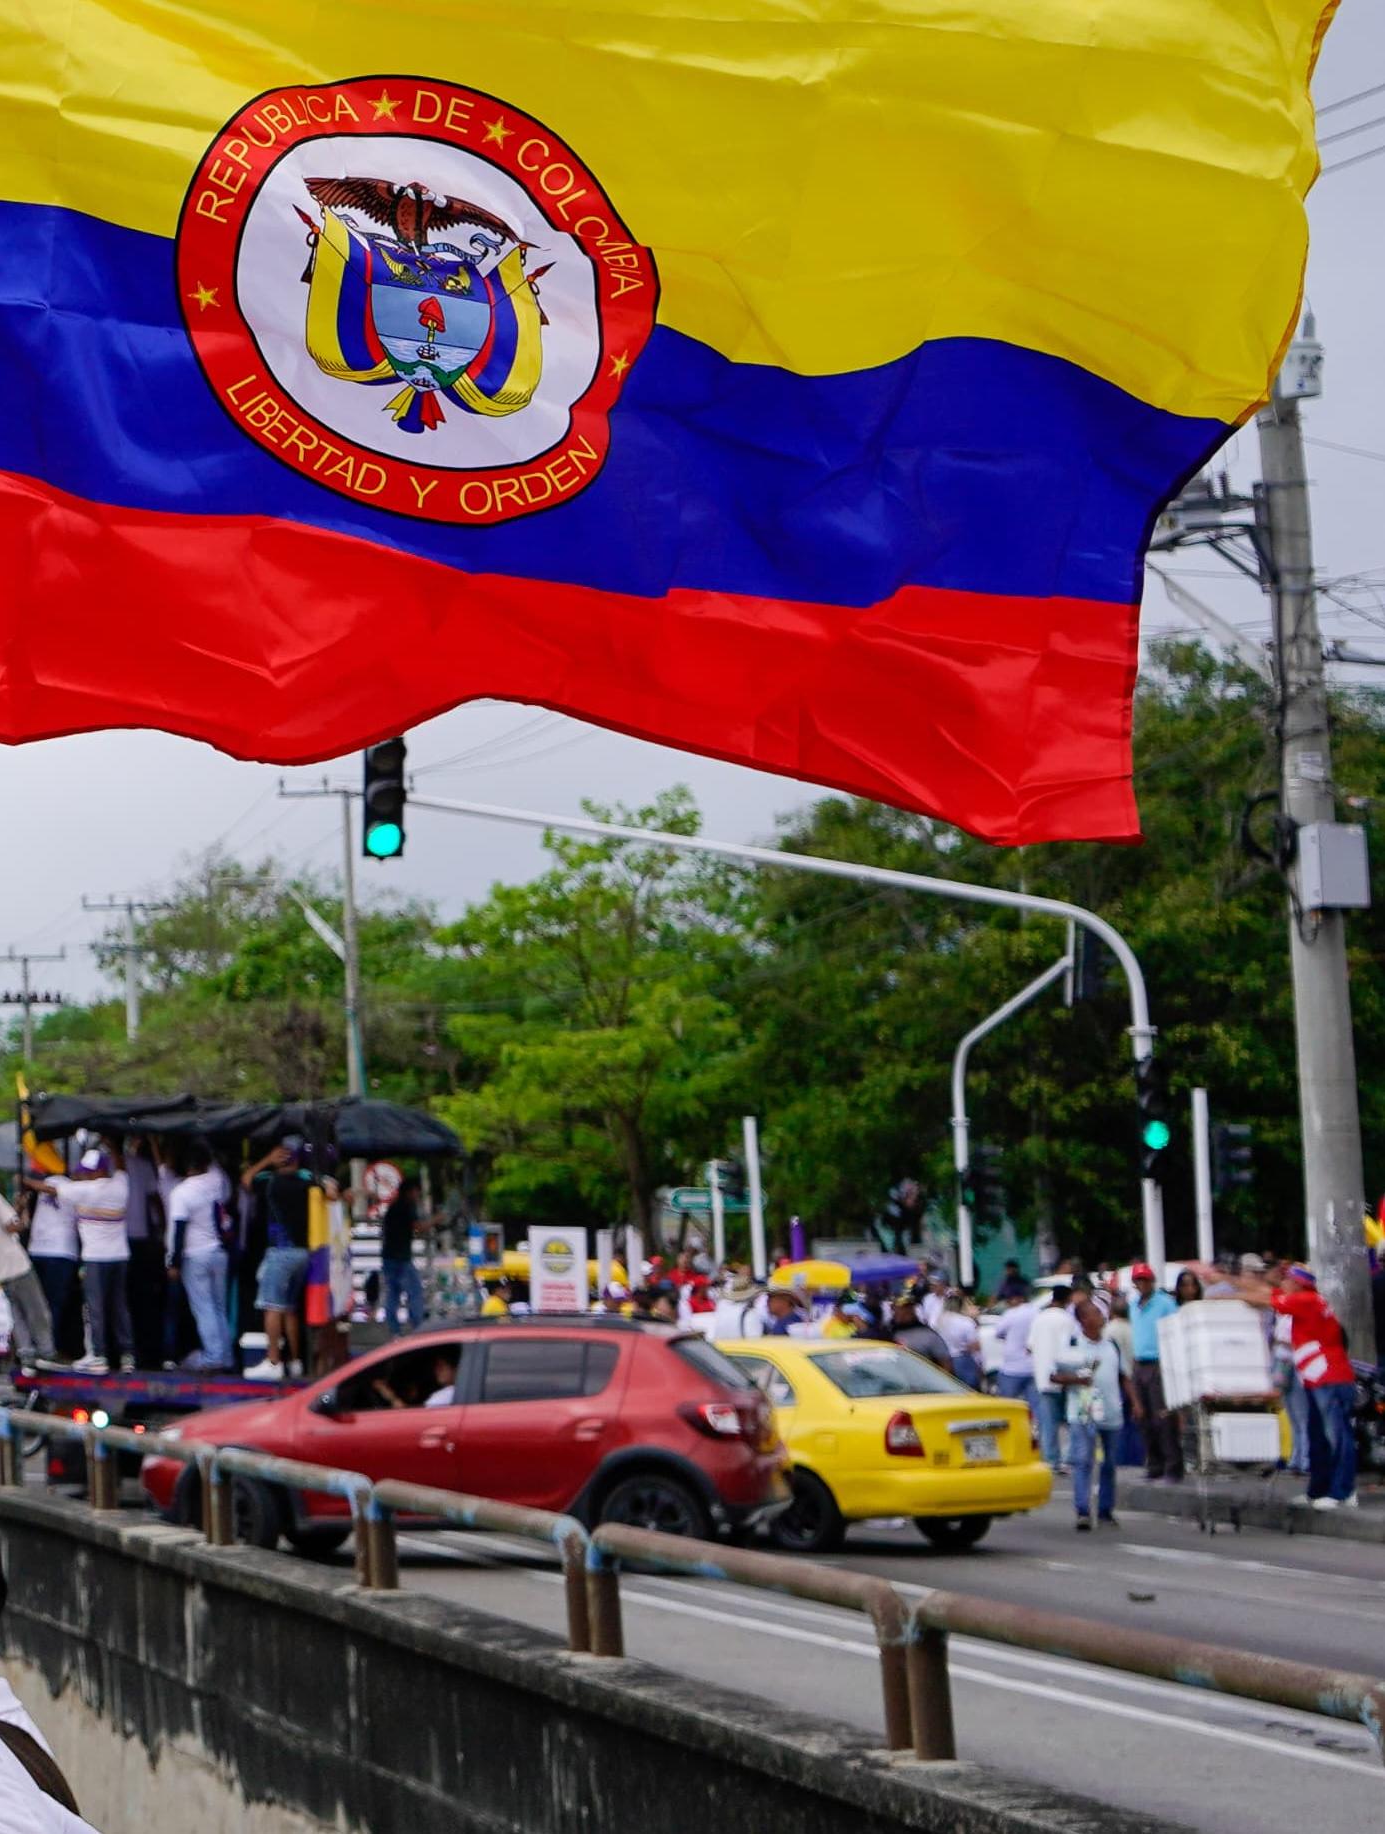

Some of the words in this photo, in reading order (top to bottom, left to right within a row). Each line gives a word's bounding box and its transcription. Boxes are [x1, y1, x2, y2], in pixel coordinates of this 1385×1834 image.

[195, 94, 359, 223] REPUBLICA
[412, 90, 475, 133] DE
[517, 139, 644, 299] COLOMBIA
[226, 375, 387, 496] LIBERTAD
[408, 478, 439, 509] Y
[459, 436, 599, 516] ORDEN
